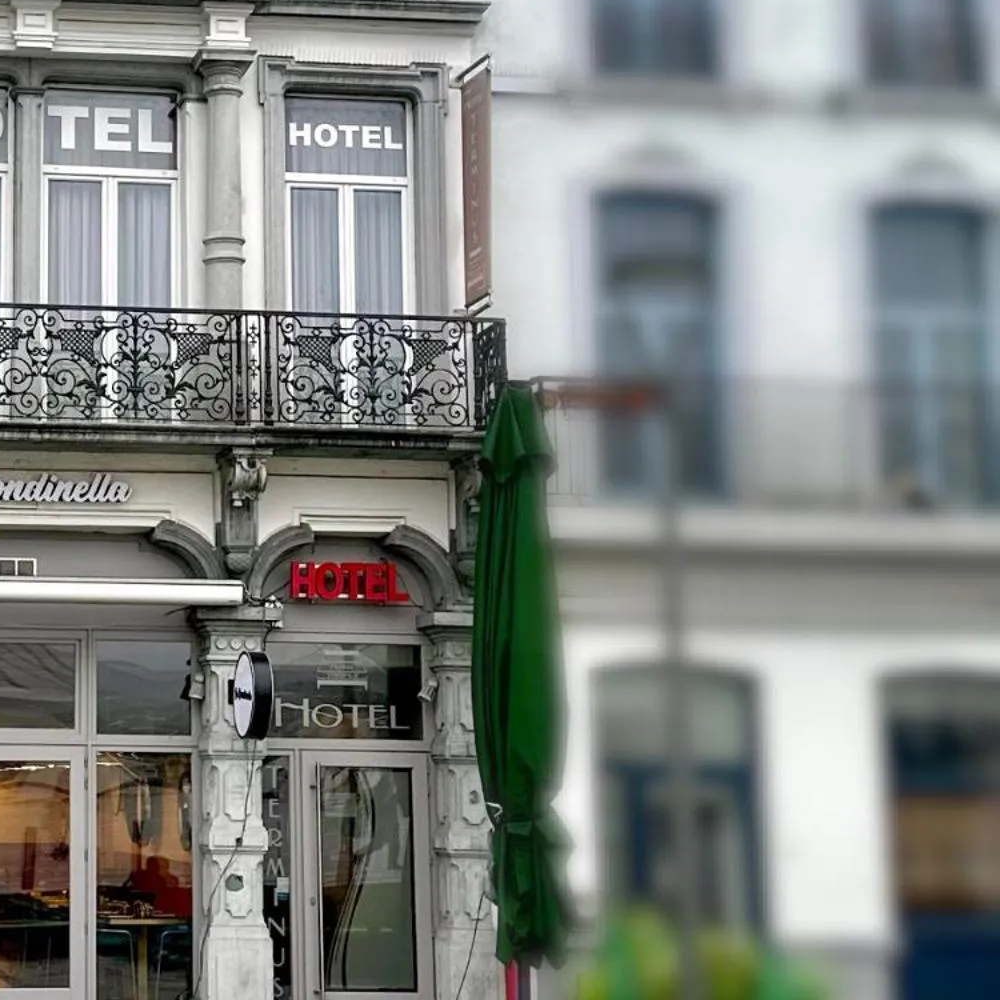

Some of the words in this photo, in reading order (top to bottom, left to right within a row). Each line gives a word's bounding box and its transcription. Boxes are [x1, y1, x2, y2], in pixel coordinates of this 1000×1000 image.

[47, 106, 173, 154] TEL
[288, 123, 403, 150] HOTEL
[291, 561, 409, 603] HOTEL
[275, 698, 410, 729] HOTEL
